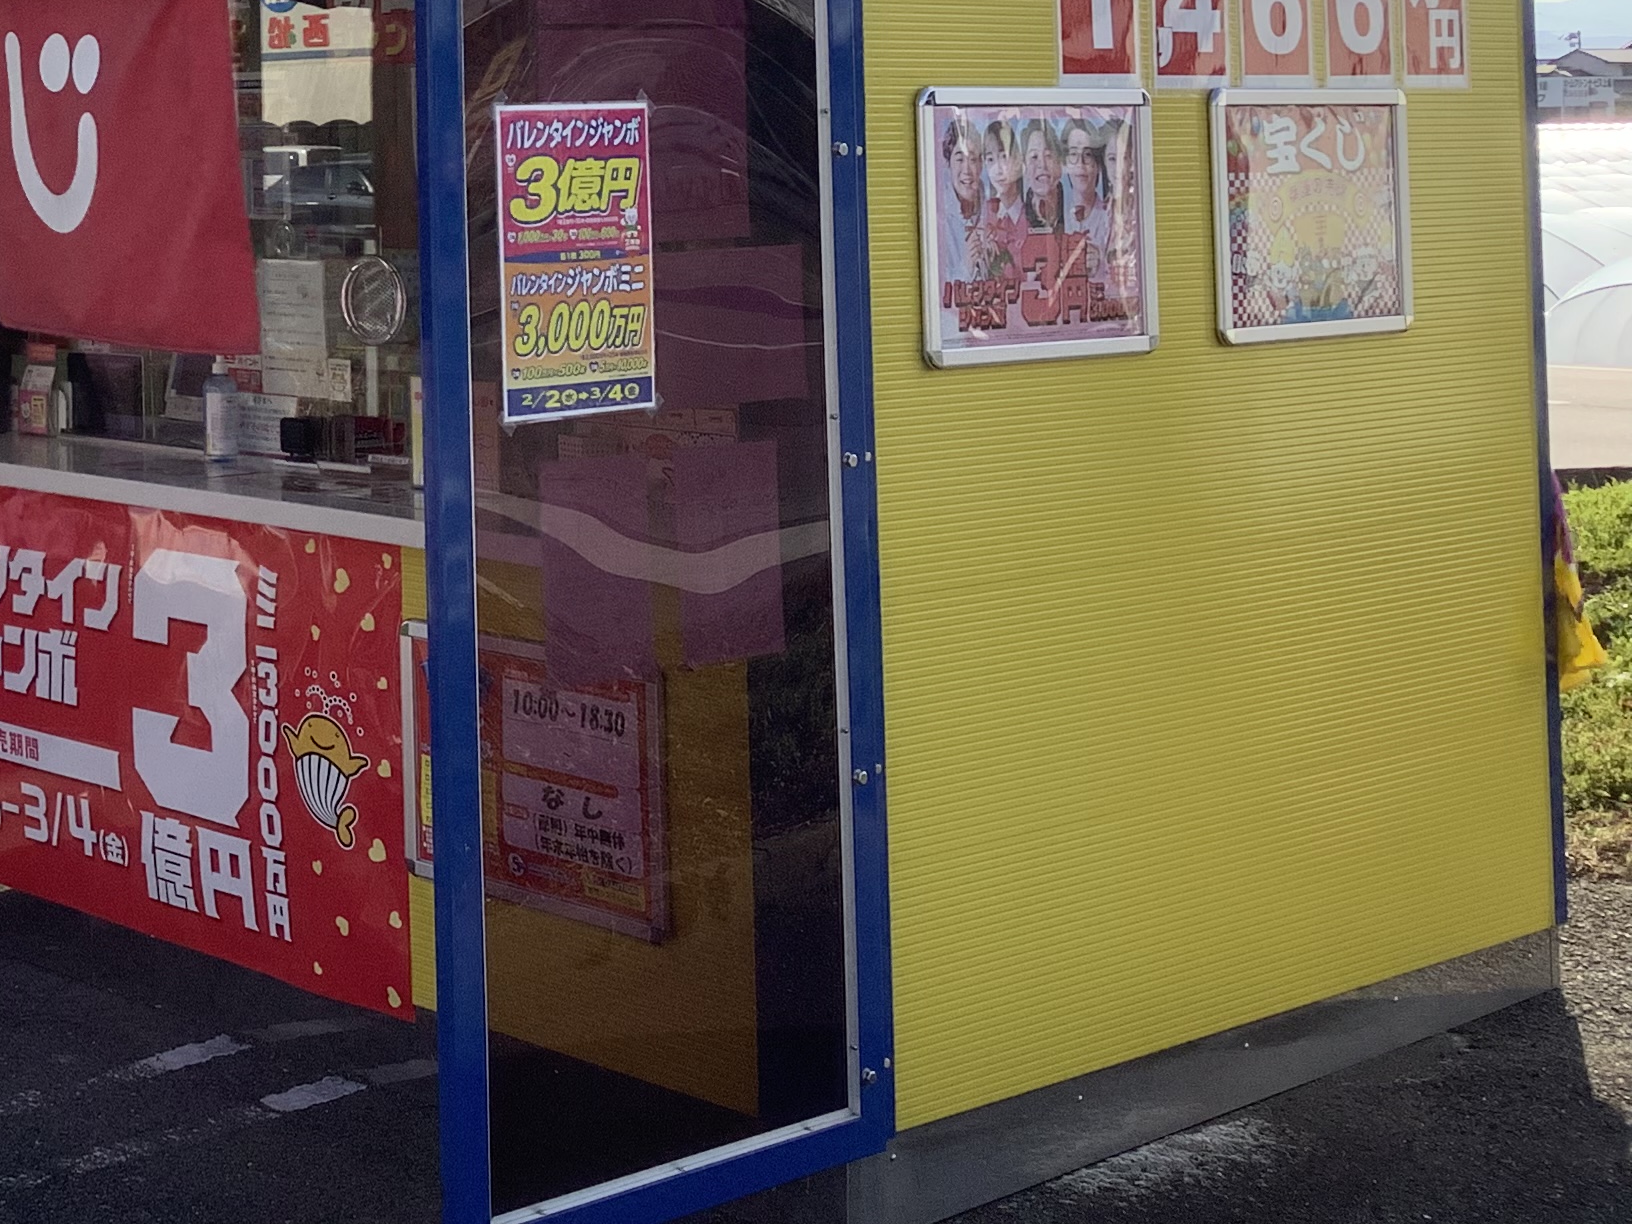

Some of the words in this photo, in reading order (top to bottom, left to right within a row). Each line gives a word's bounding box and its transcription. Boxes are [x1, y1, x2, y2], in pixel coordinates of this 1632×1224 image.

[506, 115, 641, 149] バレンタインジャンボ
[509, 155, 640, 223] 3億円
[511, 264, 646, 296] バレンタインジャンボミニ
[514, 299, 646, 358] 3,000万円
